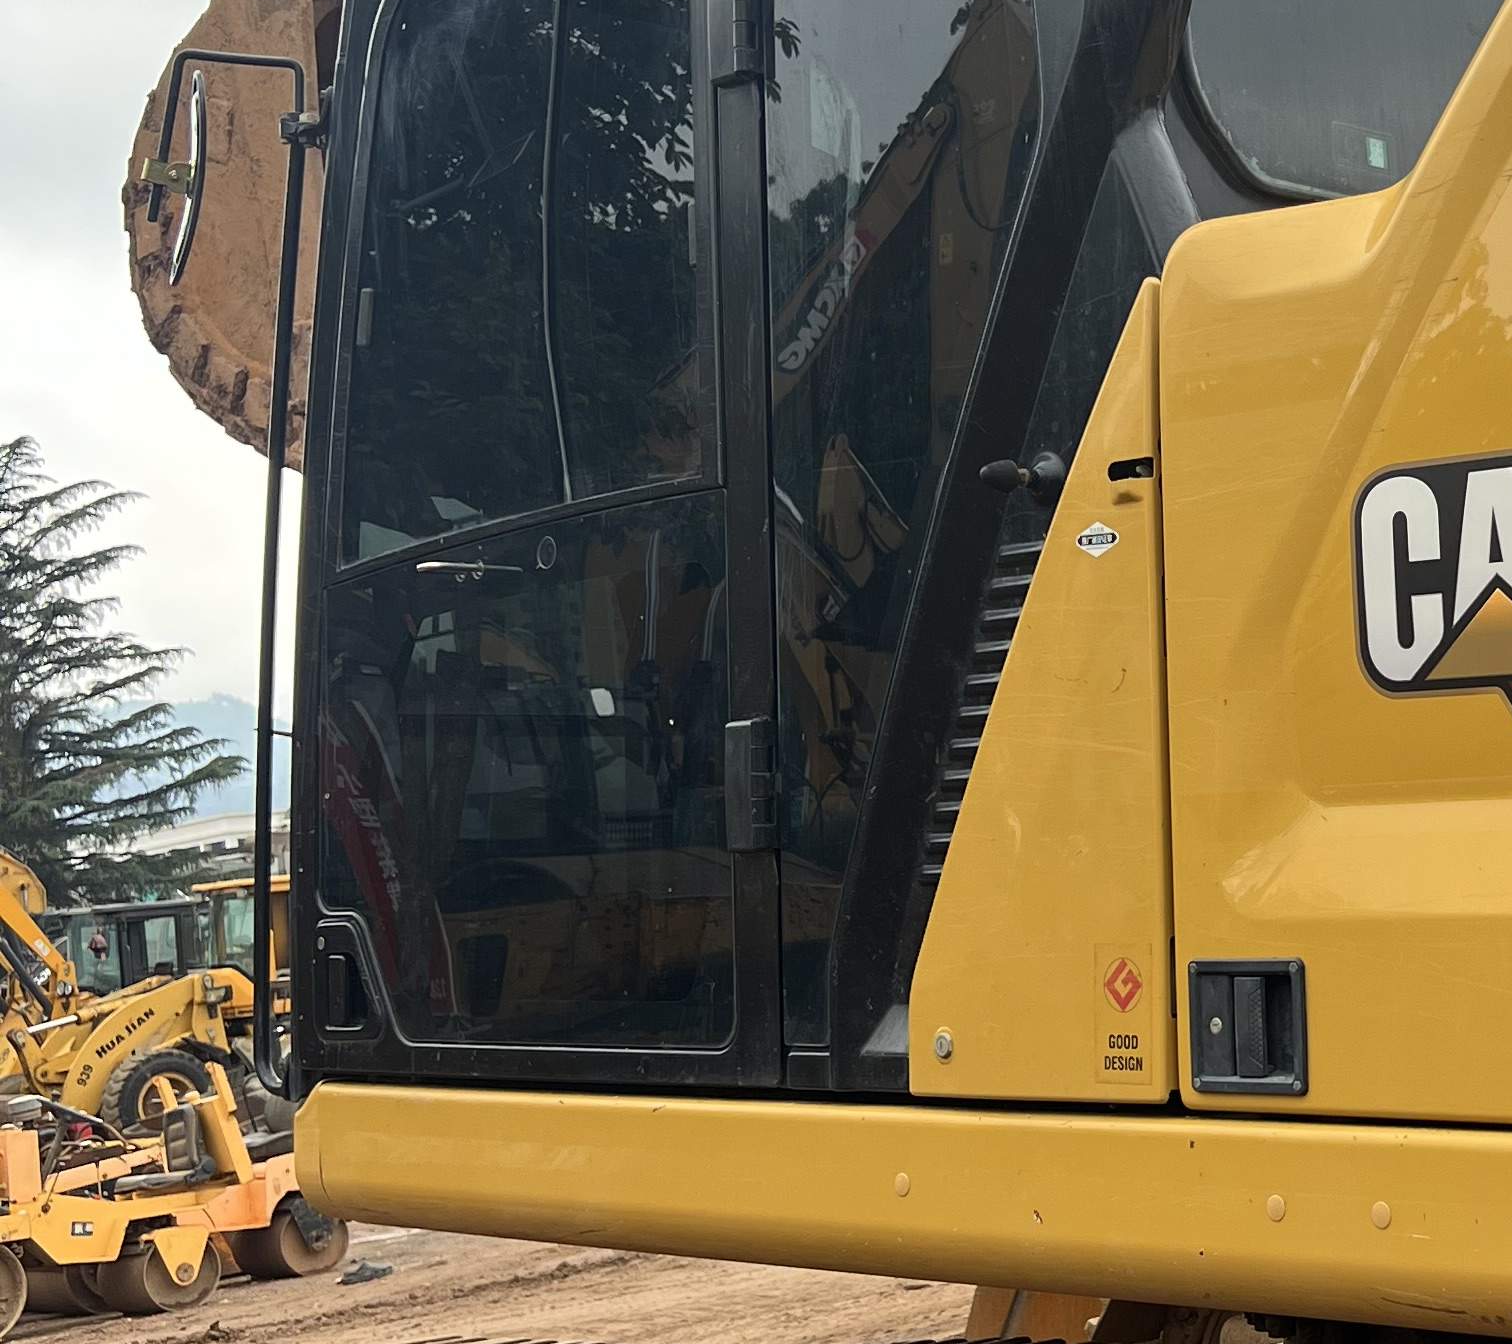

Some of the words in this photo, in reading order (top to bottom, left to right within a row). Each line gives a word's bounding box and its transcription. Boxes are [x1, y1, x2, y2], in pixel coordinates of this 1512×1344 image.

[95, 1035, 126, 1059] HUA
[1108, 1034, 1139, 1050] GOOD
[1104, 1055, 1143, 1071] DESIGN
[77, 1064, 94, 1087] 939
